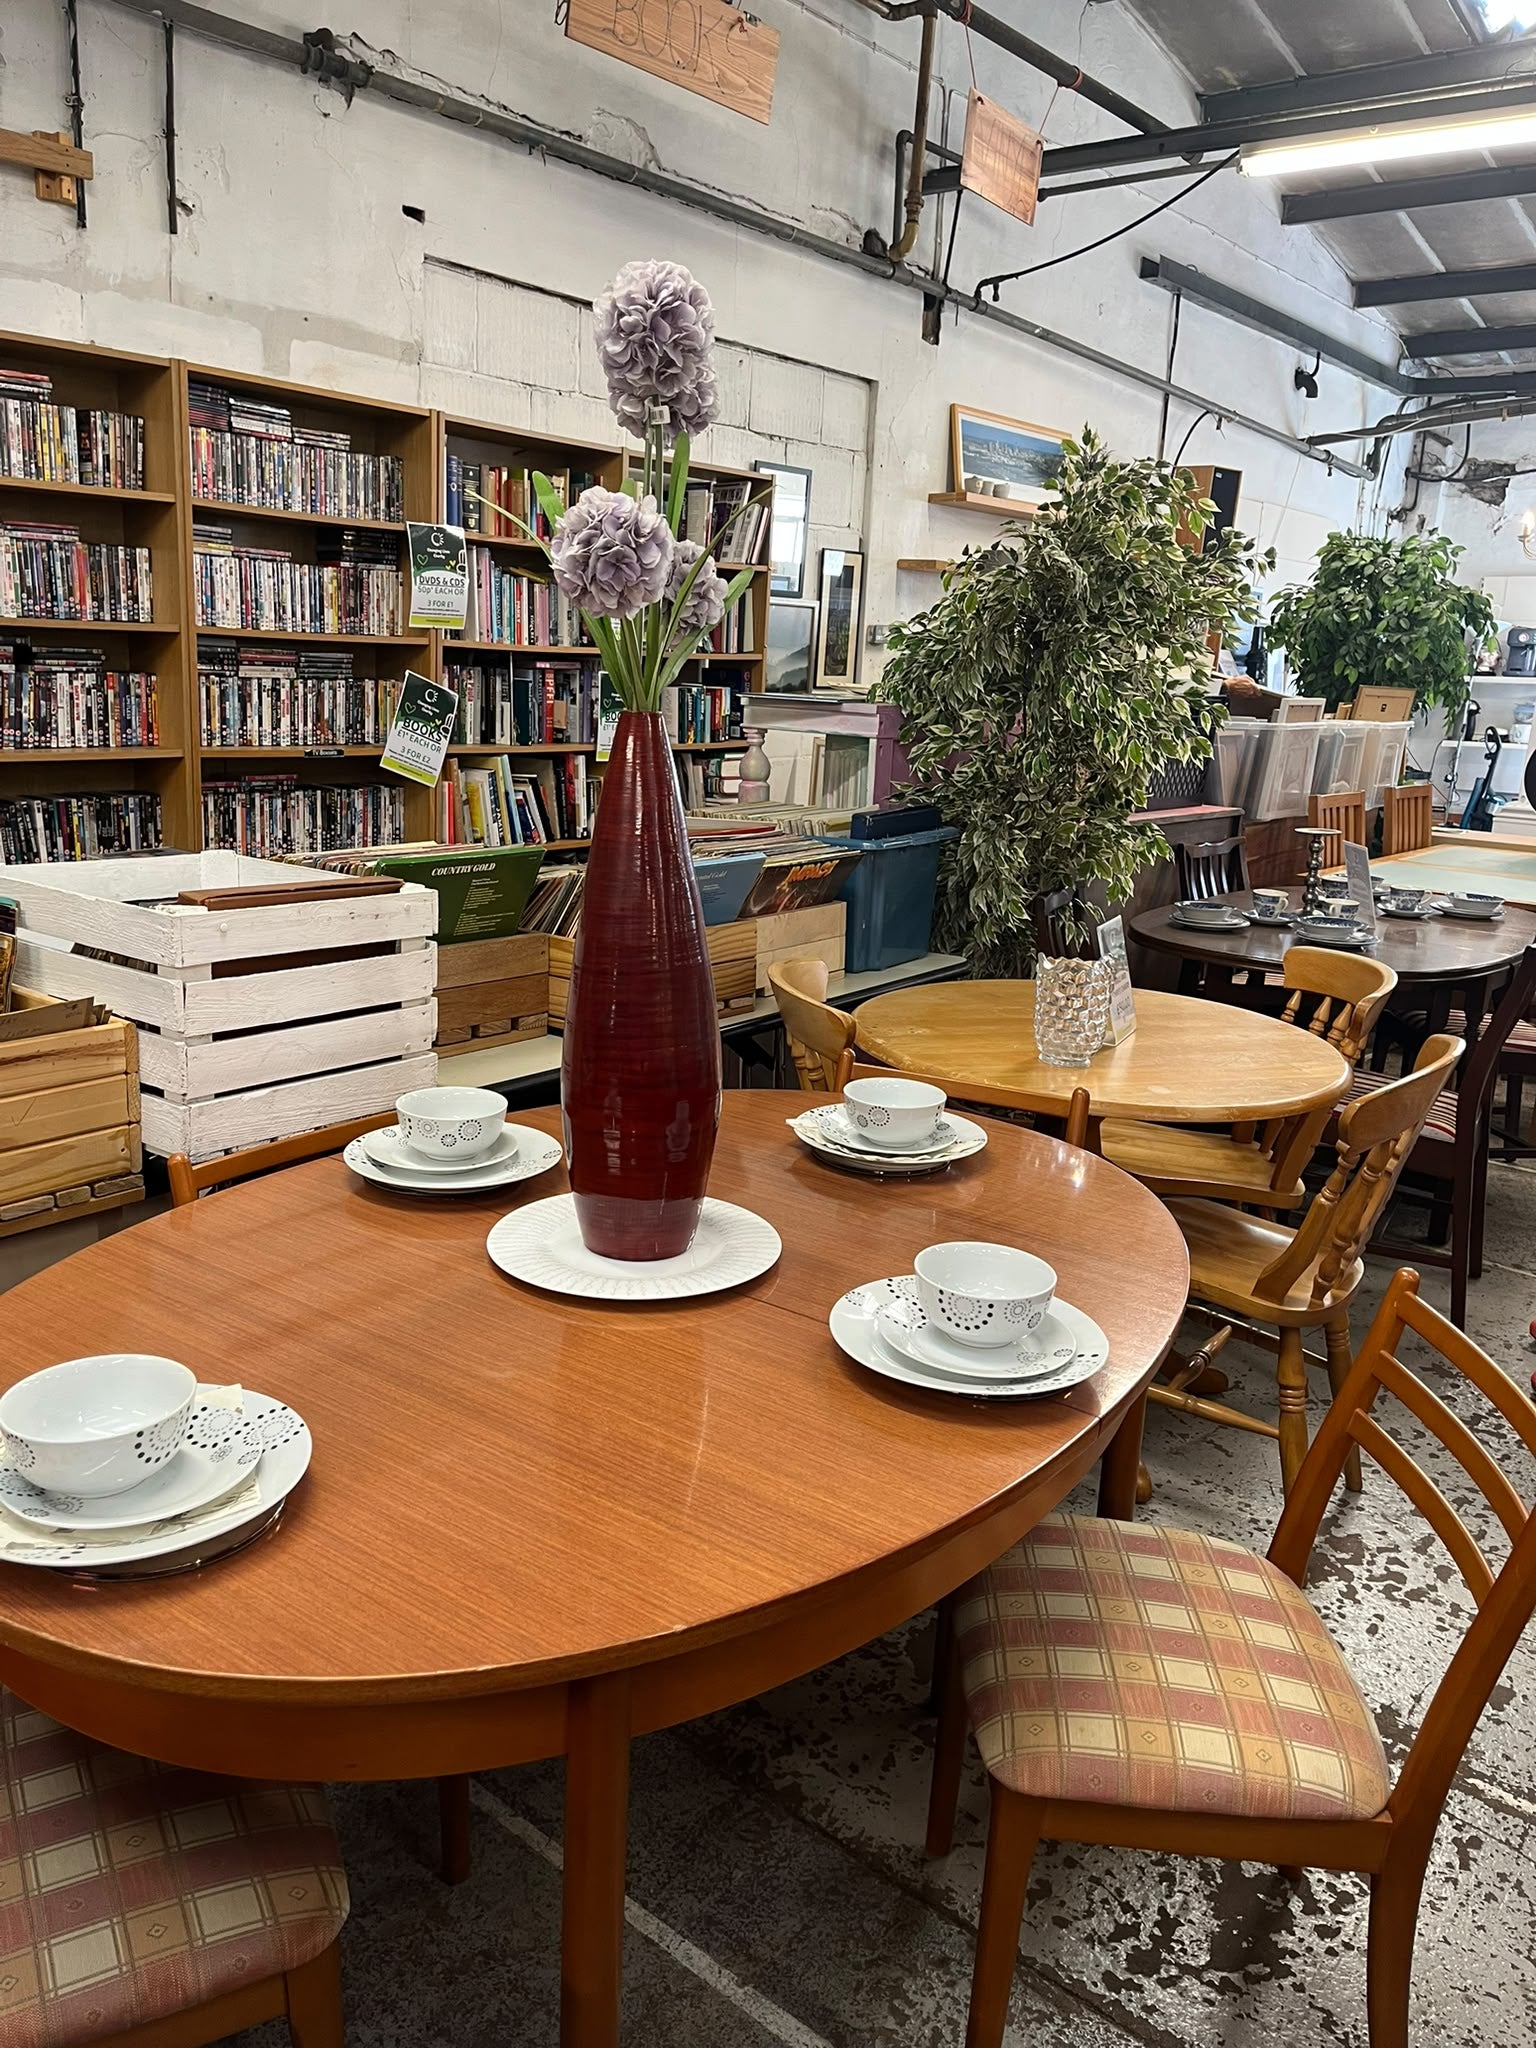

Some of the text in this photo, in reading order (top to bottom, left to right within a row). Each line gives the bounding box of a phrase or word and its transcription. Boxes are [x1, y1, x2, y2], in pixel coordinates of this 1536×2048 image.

[601, 0, 751, 95] BOOKS
[419, 575, 465, 587] DVDS & CDS
[435, 586, 454, 595] EACH
[403, 719, 442, 741] BOOKS
[409, 733, 430, 749] EACH
[430, 743, 442, 754] OR
[400, 745, 431, 764] 3 FOR £2
[431, 862, 496, 877] COUNTRY GOLD
[788, 860, 840, 883] IMPACT
